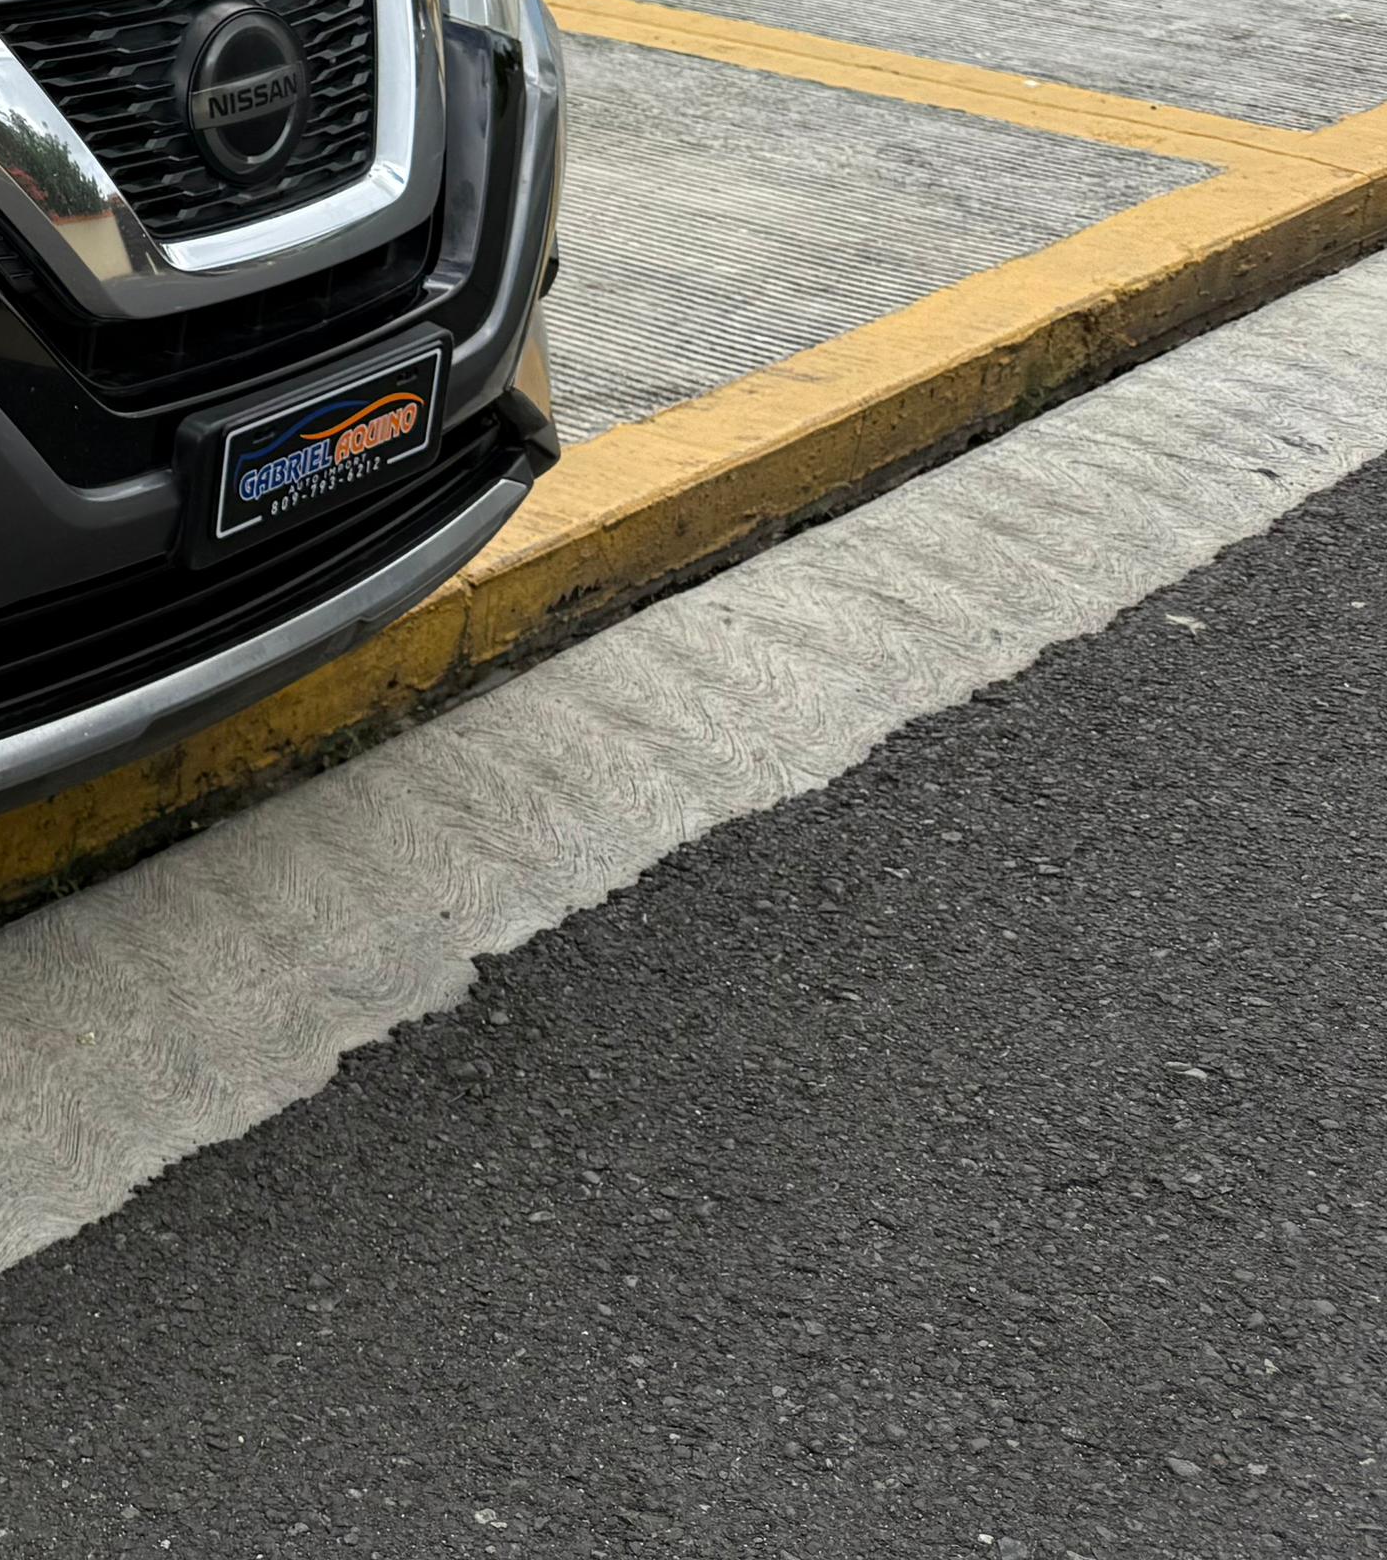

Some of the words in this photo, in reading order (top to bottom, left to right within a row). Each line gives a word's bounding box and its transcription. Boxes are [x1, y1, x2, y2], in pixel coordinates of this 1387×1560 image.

[208, 72, 297, 119] NISSAN
[239, 438, 333, 502] GABRIEL
[334, 402, 417, 466] AQUINO
[270, 456, 381, 515] 809-793-6212
[288, 475, 319, 494] AUTO
